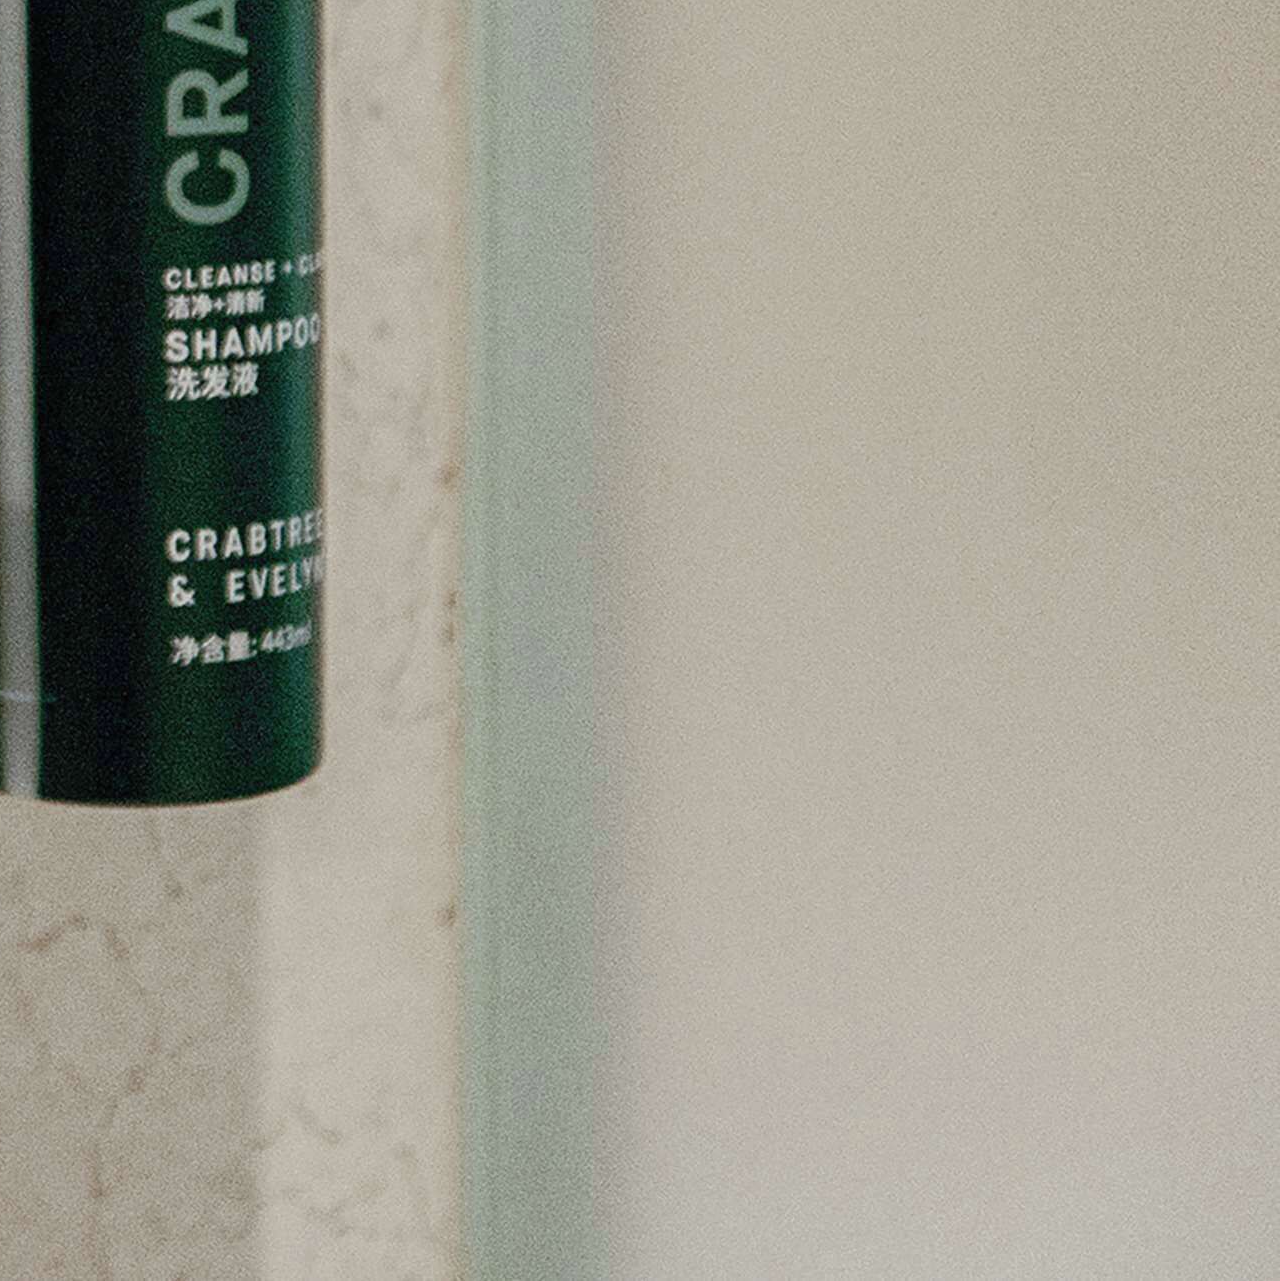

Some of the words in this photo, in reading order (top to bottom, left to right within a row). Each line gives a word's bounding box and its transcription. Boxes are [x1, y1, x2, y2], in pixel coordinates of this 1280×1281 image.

[163, 260, 276, 290] CLEANSE
[164, 313, 321, 363] SHAMPOO
[166, 361, 260, 402] 洗发液
[166, 509, 322, 563] CRABTREE
[168, 574, 196, 608] &
